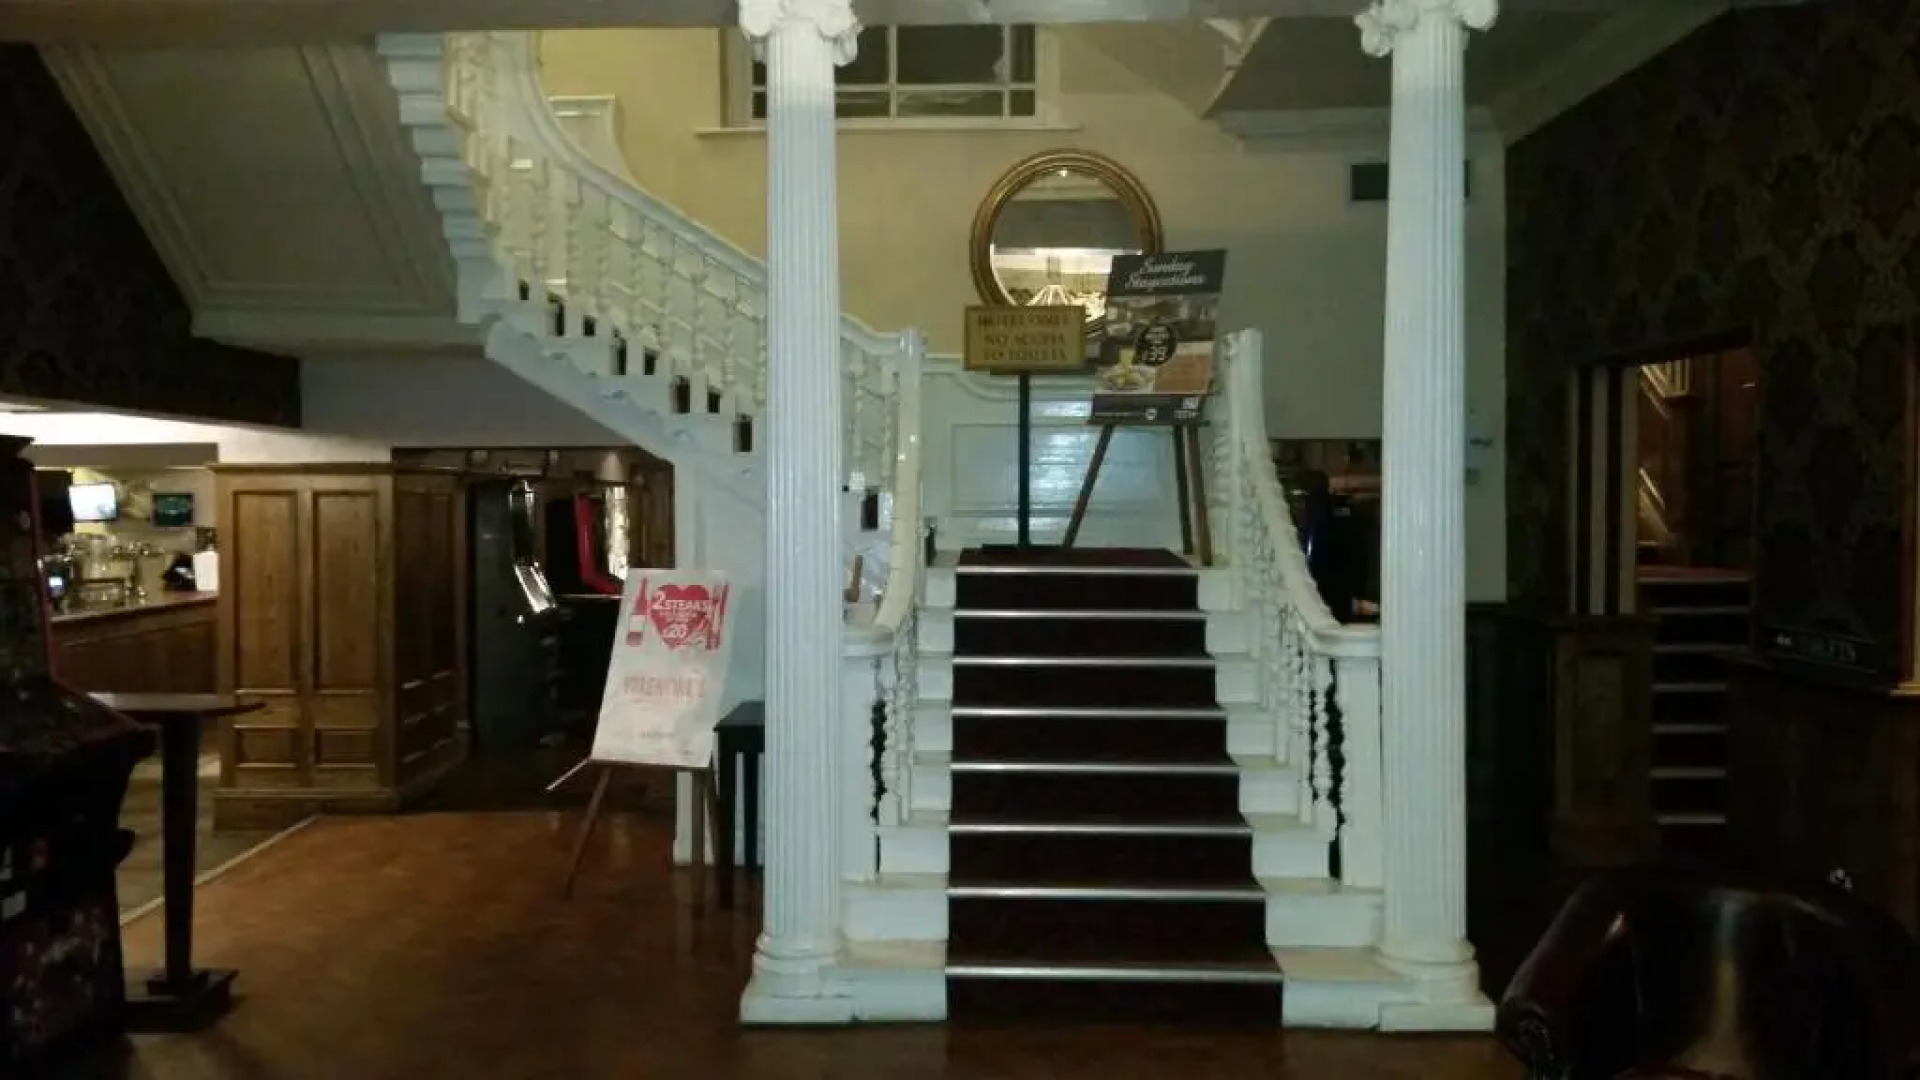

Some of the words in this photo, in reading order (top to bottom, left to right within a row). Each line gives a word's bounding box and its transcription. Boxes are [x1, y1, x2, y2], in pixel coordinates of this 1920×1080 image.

[1140, 256, 1197, 275] Sunday
[984, 333, 1008, 346] NO
[984, 347, 1005, 361] TO
